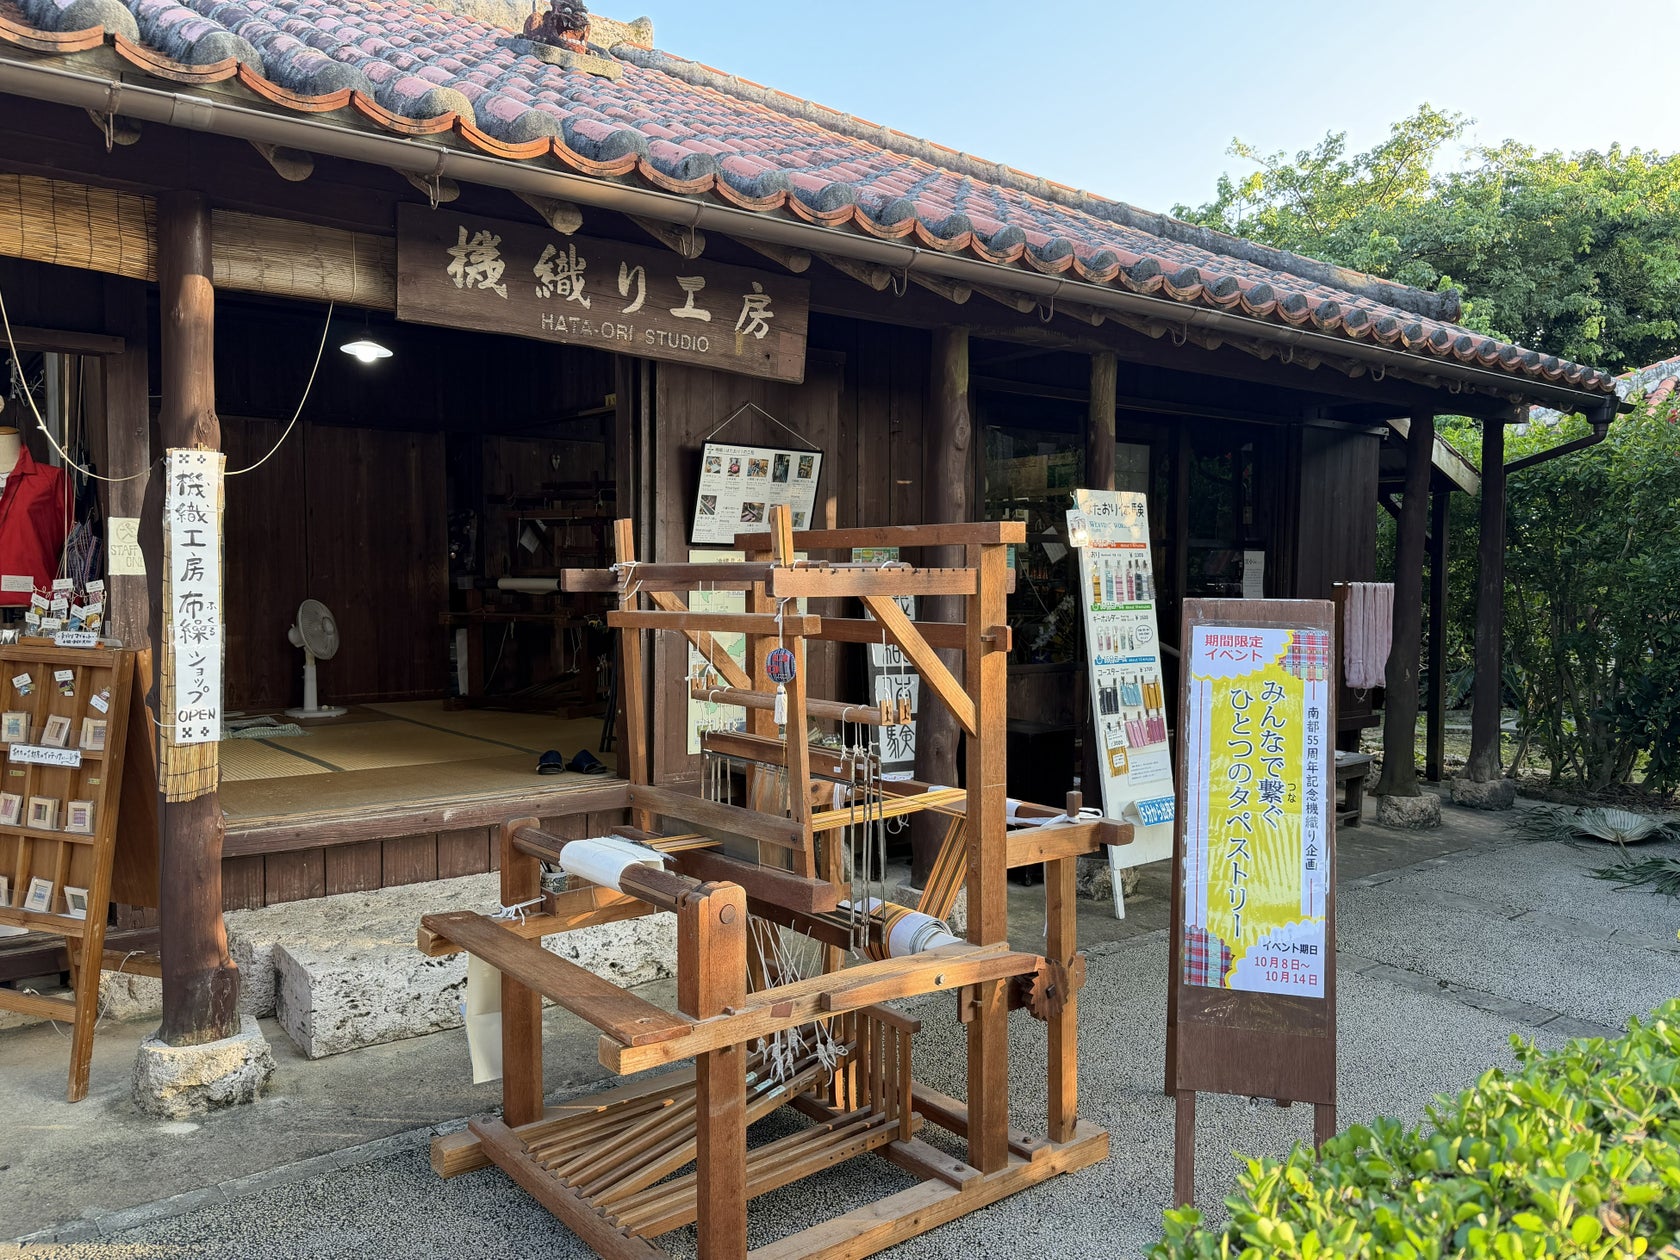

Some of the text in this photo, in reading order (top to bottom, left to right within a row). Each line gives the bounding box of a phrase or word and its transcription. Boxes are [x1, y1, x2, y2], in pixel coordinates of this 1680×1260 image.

[446, 224, 775, 340] 機織り工房
[541, 312, 710, 353] HATA-ORI STUDIO
[206, 601, 217, 636] ふくる
[1204, 634, 1263, 649] 期間限定
[1204, 648, 1263, 662] イベント
[1097, 668, 1120, 677] コースター
[178, 708, 216, 722] OPEN
[1257, 681, 1286, 829] みんなで繋ぐ
[1287, 783, 1296, 803] つな
[1305, 706, 1319, 871] 南都55周年記念機織り企画
[1226, 688, 1254, 938] ひとつのタペストリー
[1262, 941, 1318, 955] イベント期日
[1265, 971, 1318, 986] 10月14日
